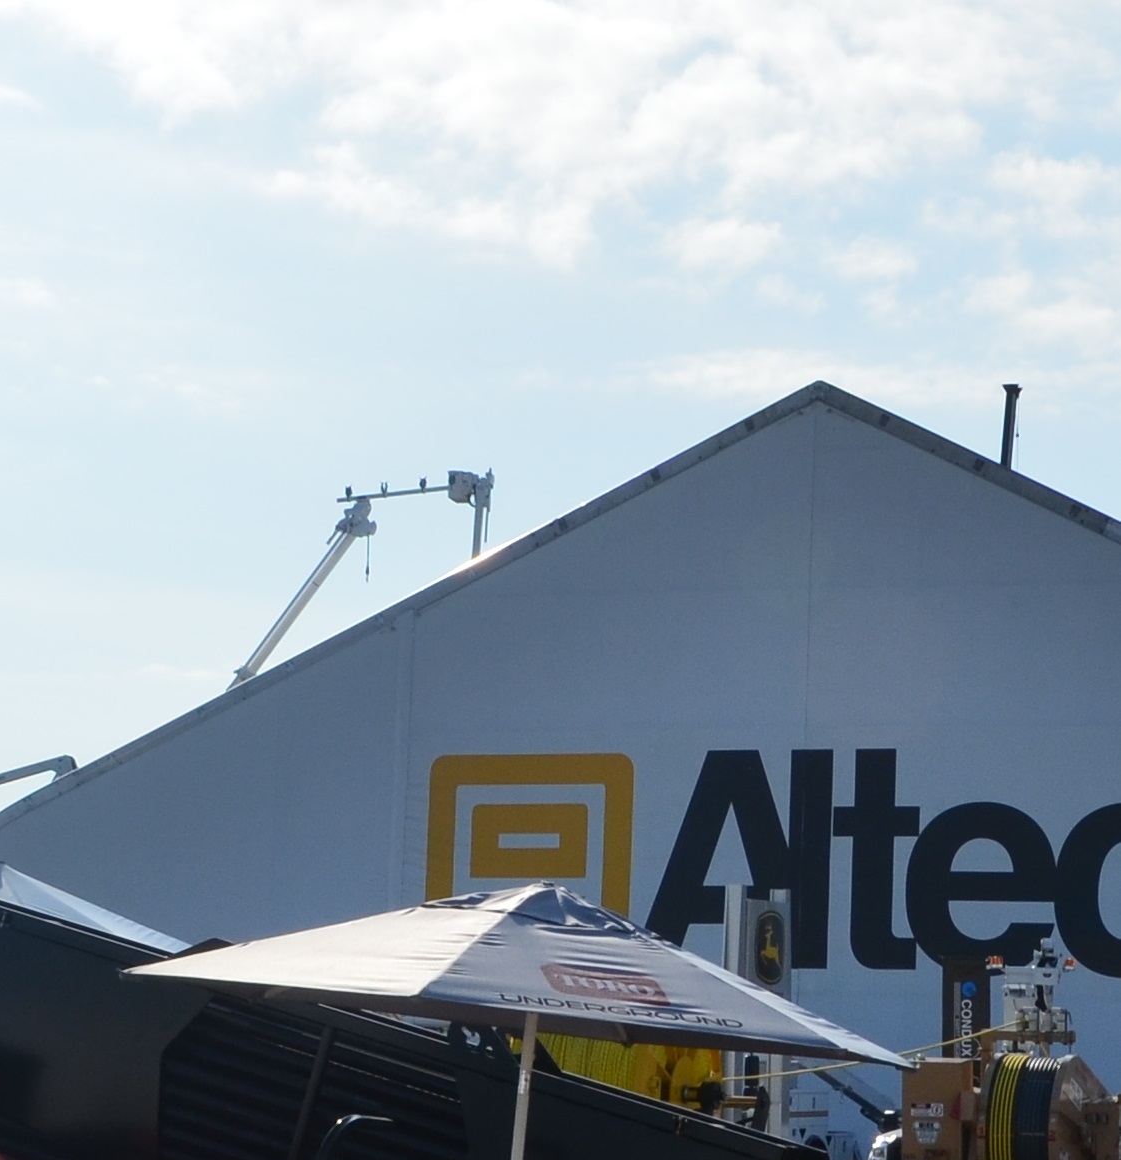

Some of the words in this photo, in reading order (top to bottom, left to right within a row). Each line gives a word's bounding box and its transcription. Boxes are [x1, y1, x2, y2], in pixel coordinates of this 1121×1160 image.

[554, 973, 656, 998] TORO
[499, 993, 744, 1029] UNDERGROUND
[961, 1000, 972, 1056] CONDUX
